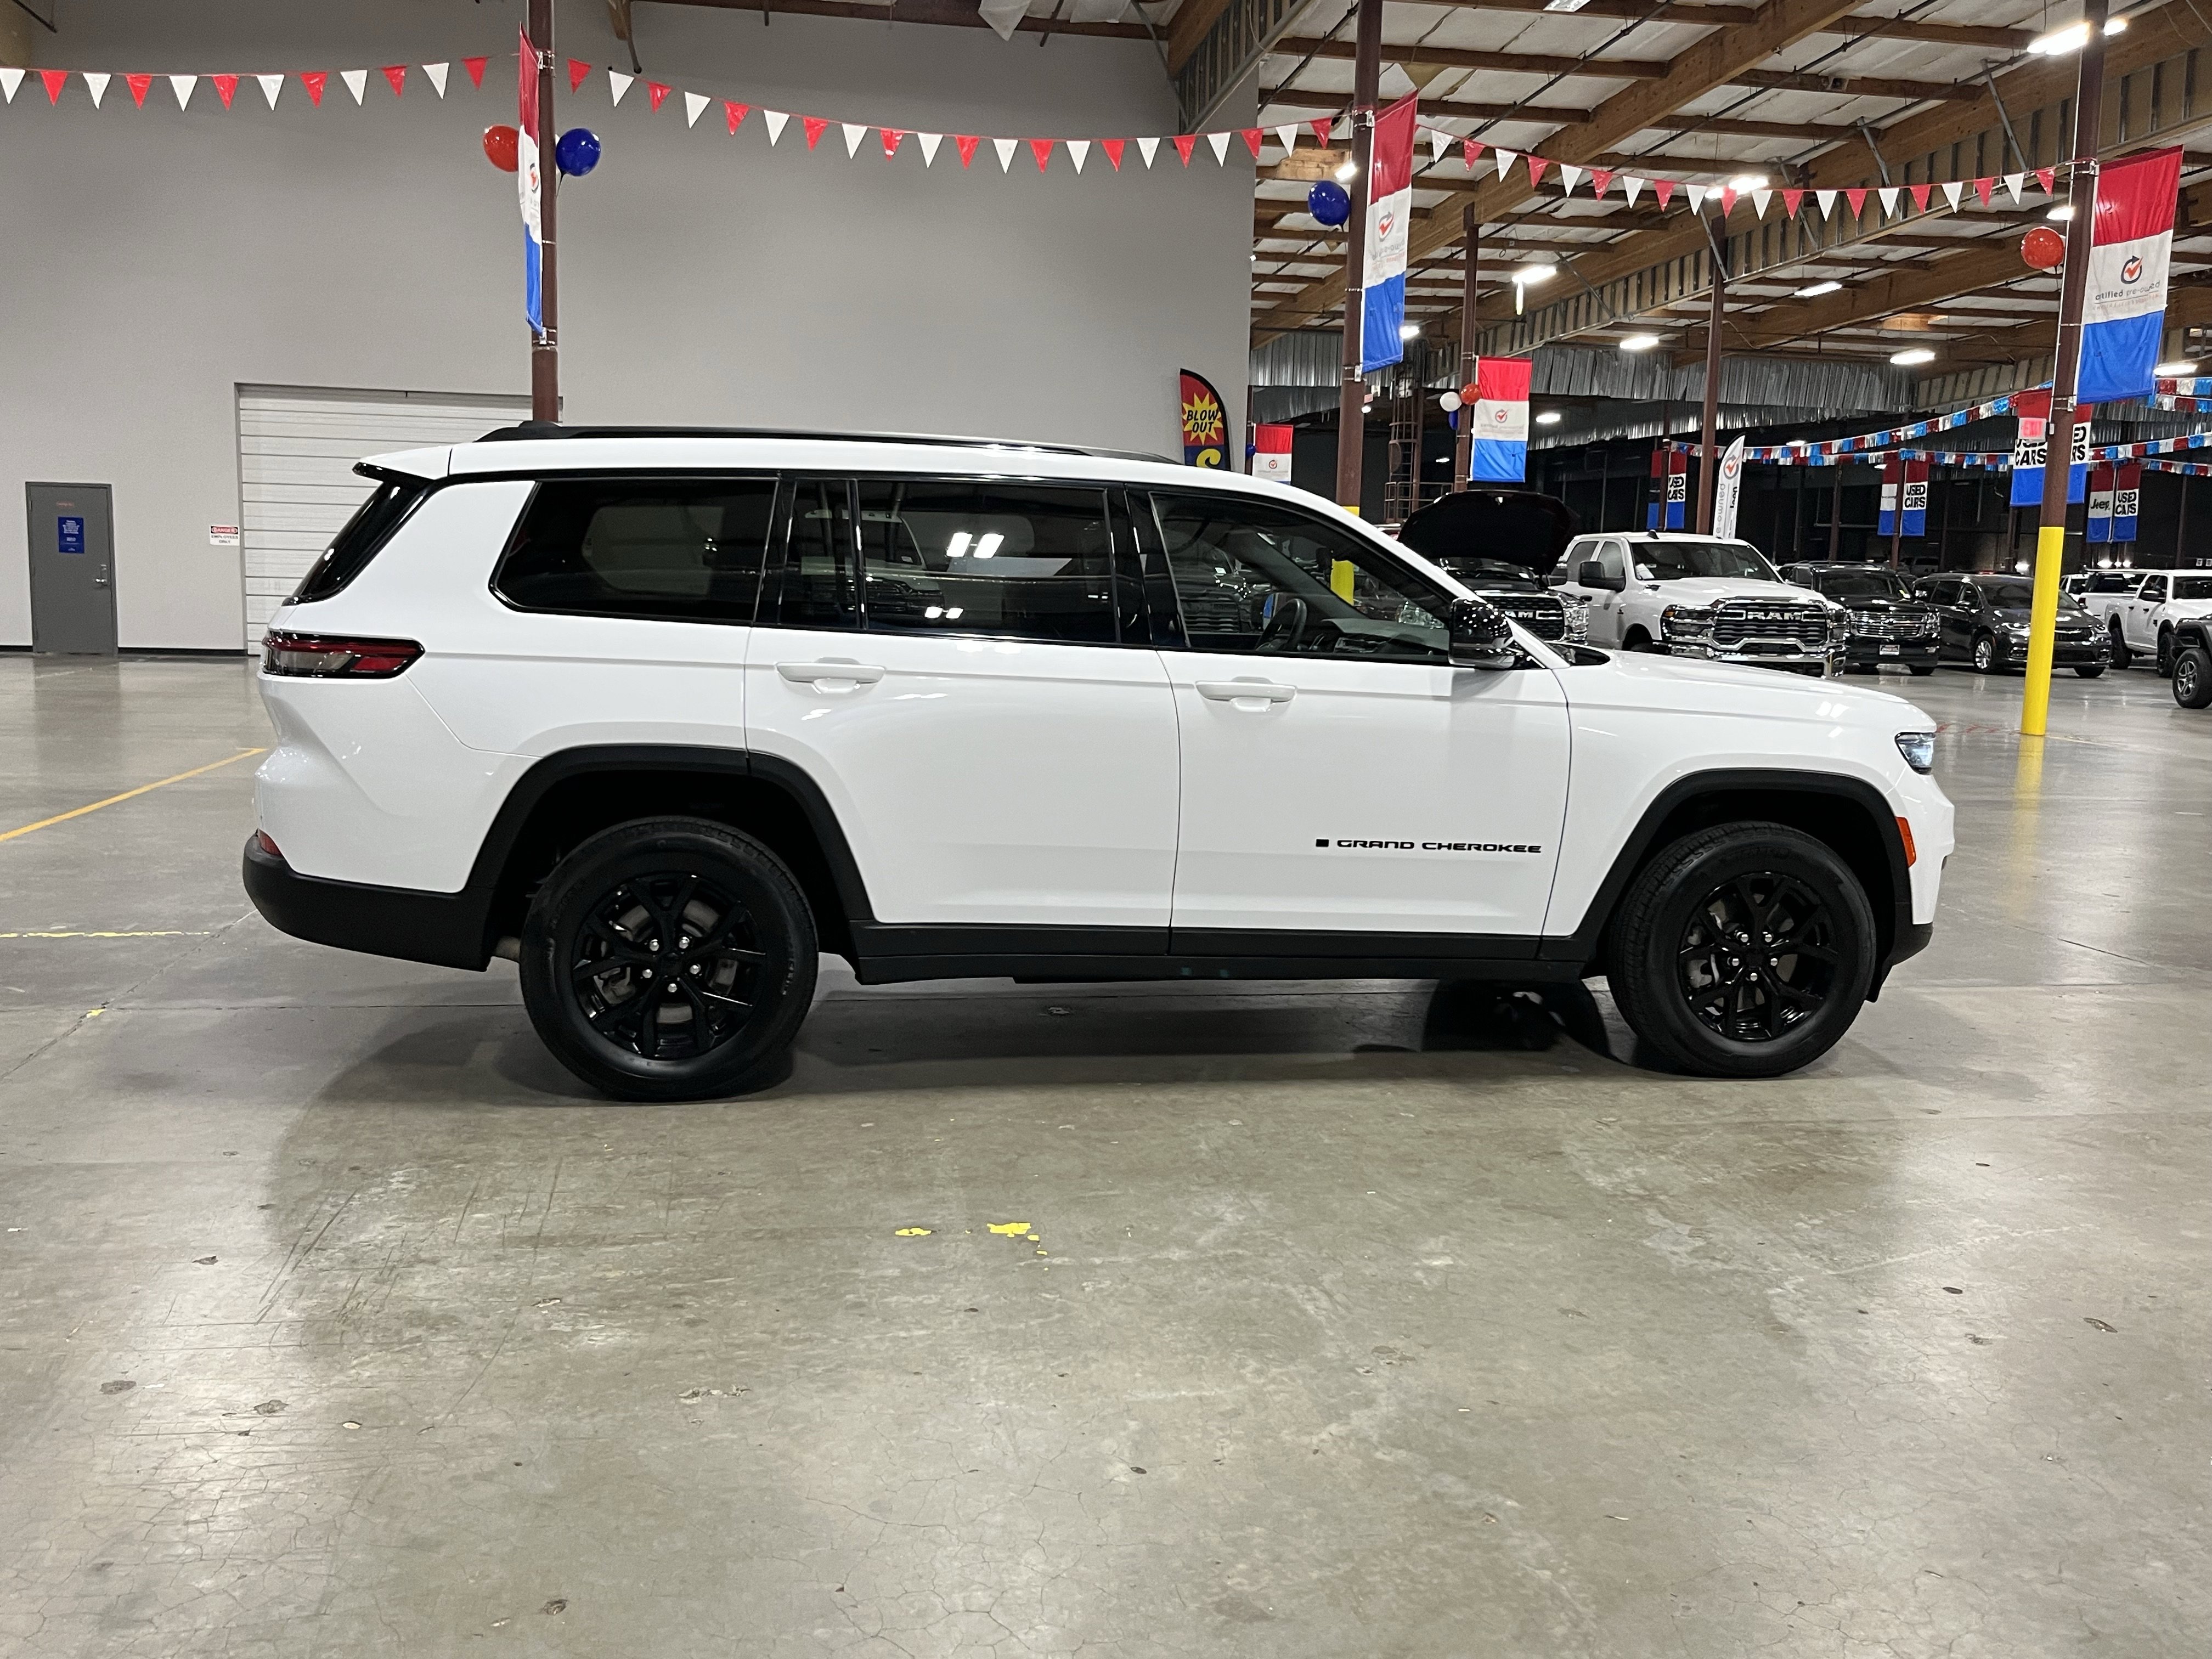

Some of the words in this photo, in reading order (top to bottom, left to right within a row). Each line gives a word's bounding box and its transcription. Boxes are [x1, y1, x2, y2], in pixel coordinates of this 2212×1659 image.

[1187, 410, 1219, 421] BLOW
[1192, 421, 1215, 433] OUT
[2073, 426, 2086, 443] ED
[2015, 448, 2047, 466] CARS
[2072, 444, 2085, 461] RS
[1906, 484, 1926, 496] USED
[1504, 610, 1533, 618] AM
[1747, 611, 1802, 620] RAM
[1337, 840, 1415, 849] GRAND
[1421, 842, 1542, 854] CHEROKEE
